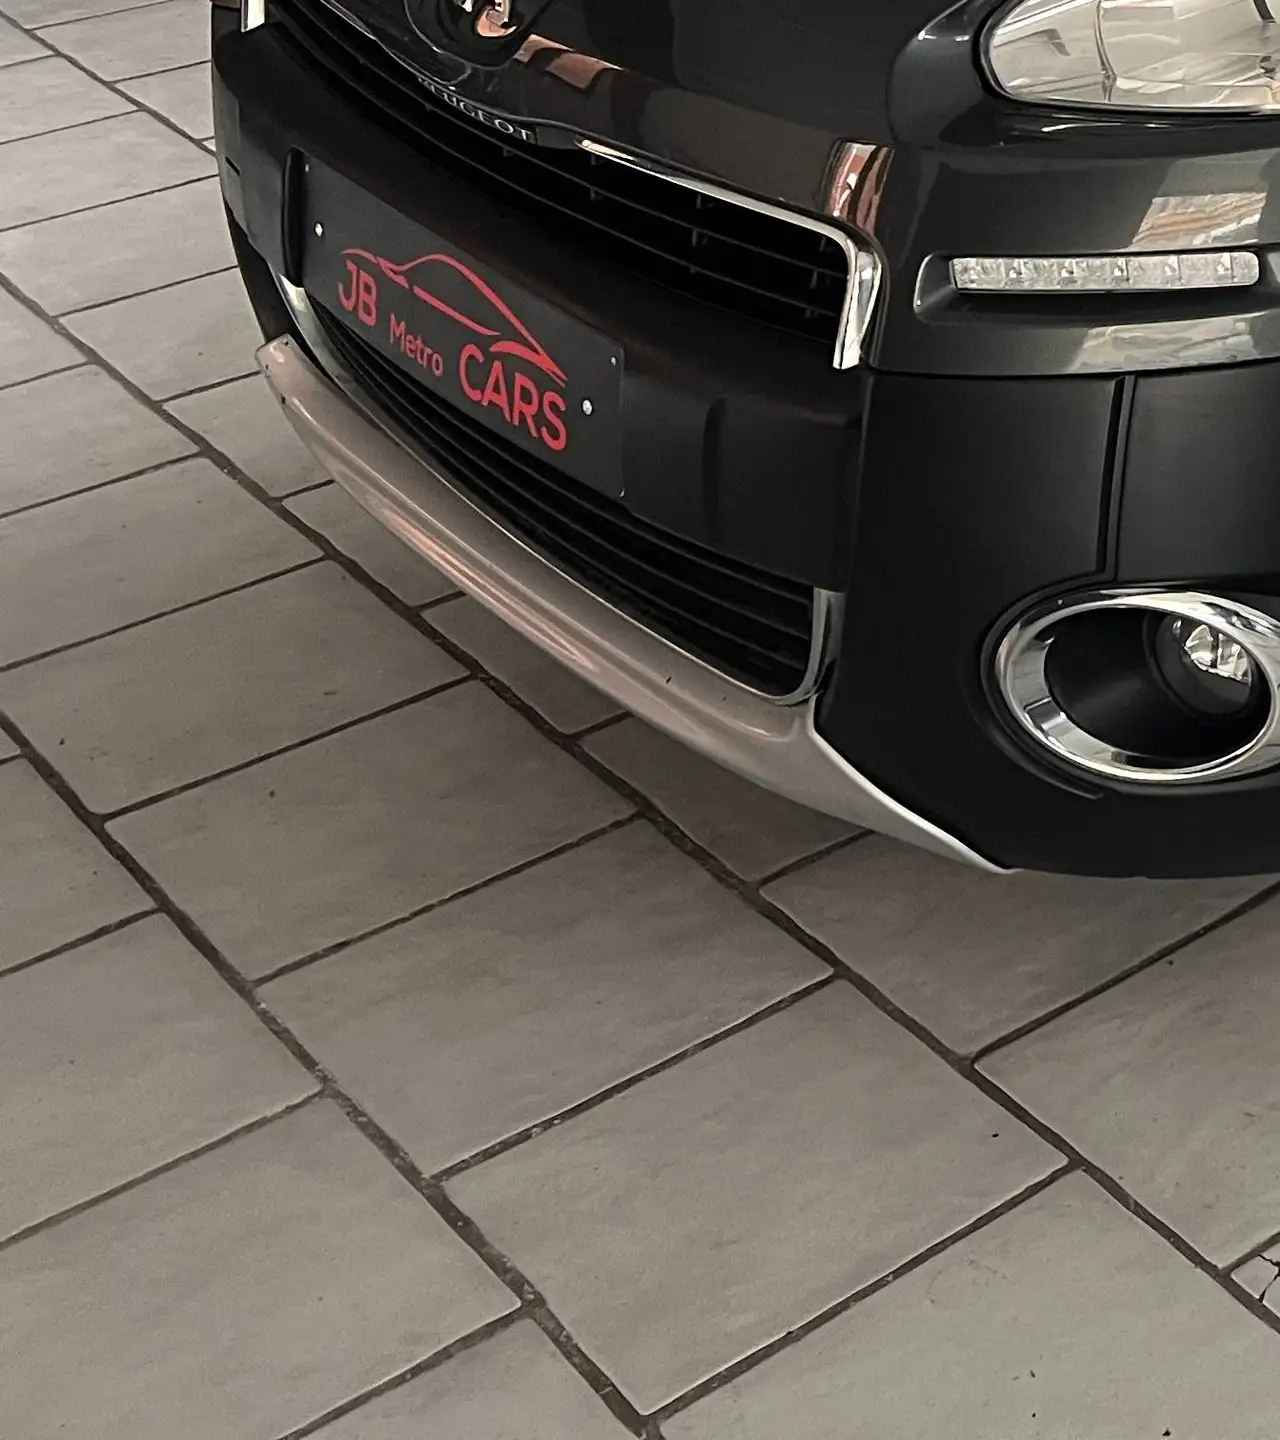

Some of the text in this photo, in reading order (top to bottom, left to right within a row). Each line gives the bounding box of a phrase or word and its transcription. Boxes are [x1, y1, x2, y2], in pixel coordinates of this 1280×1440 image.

[337, 258, 568, 452] JB Metro CARS
